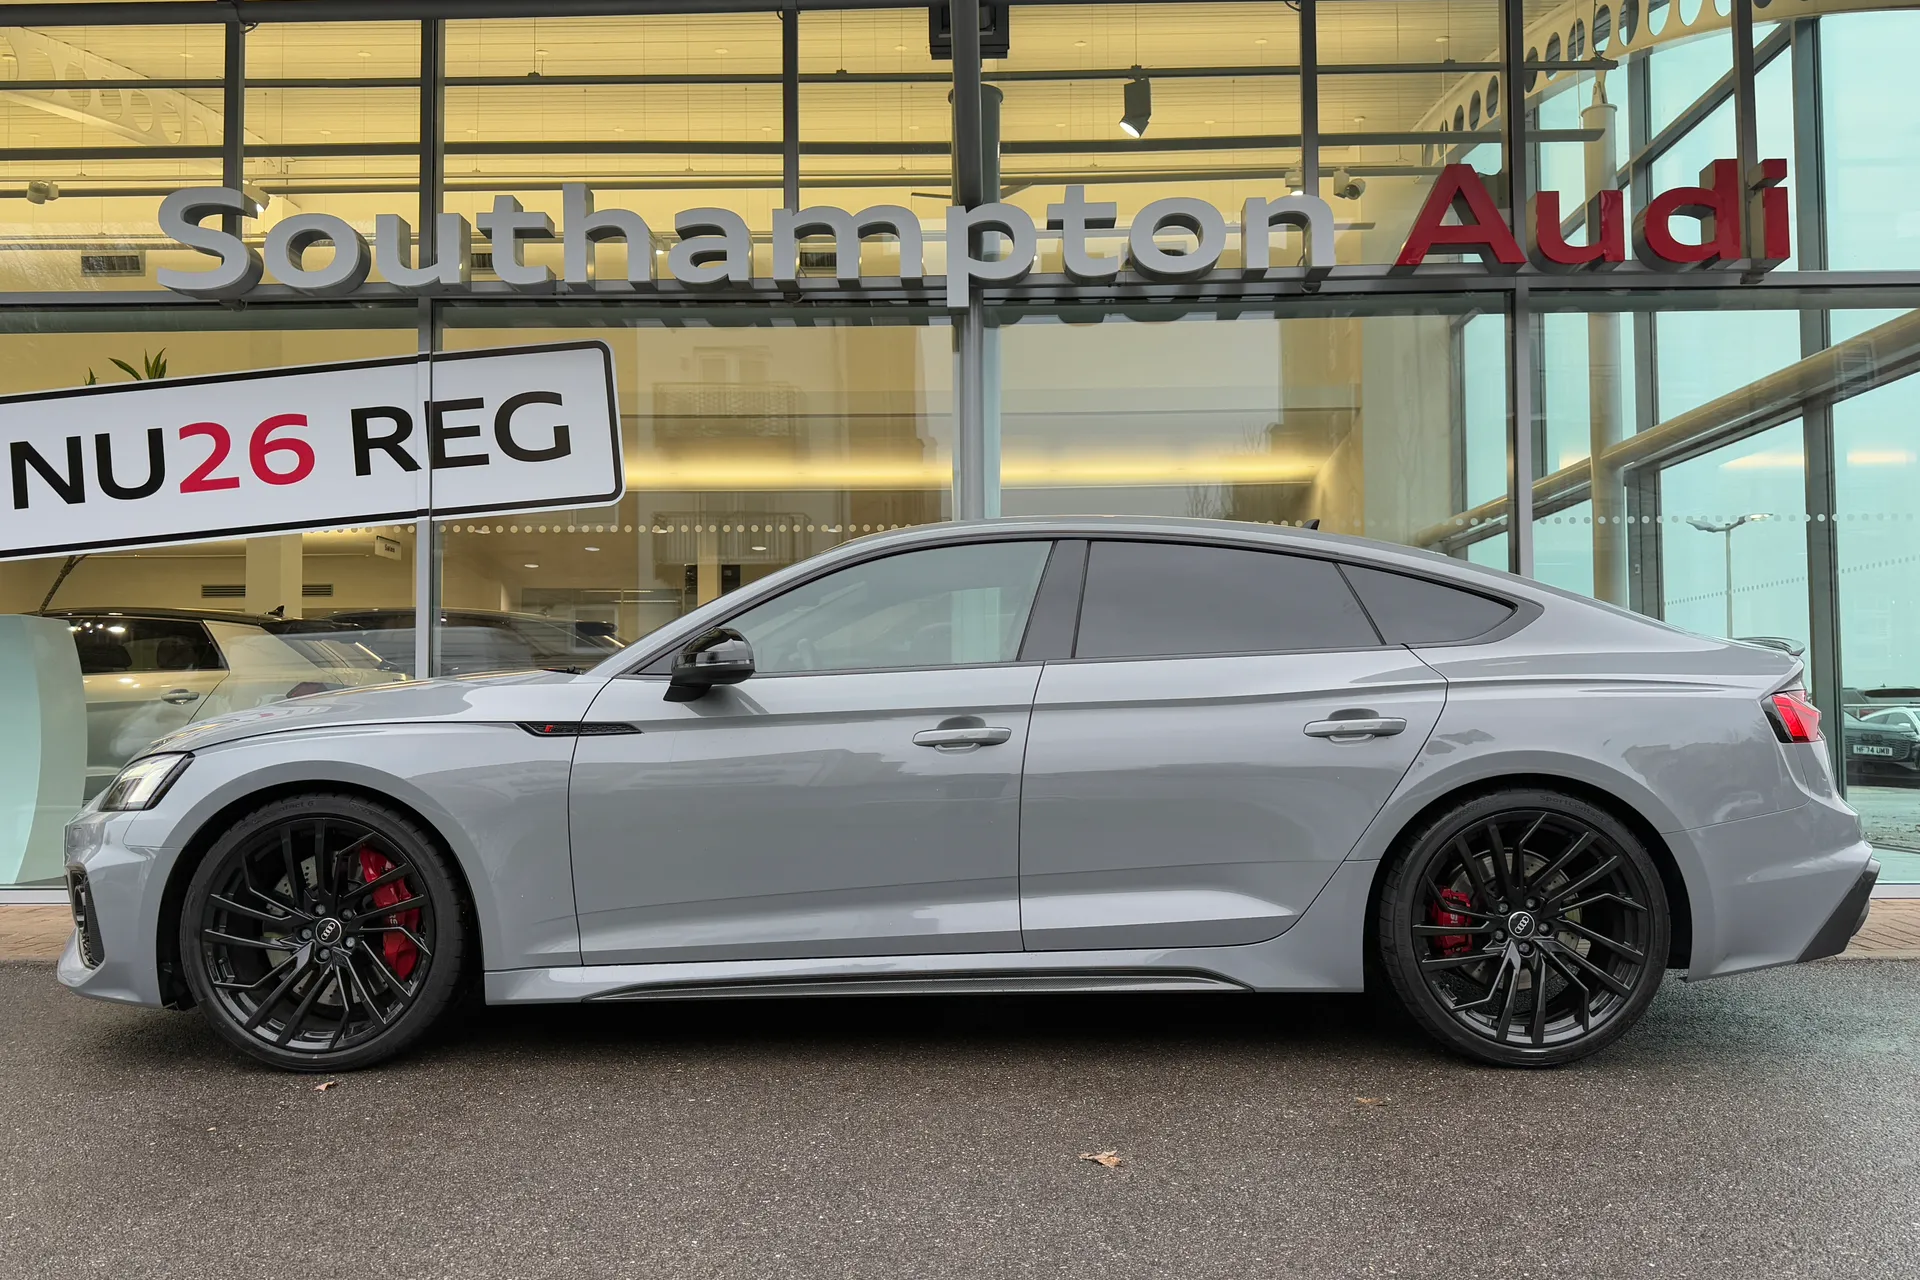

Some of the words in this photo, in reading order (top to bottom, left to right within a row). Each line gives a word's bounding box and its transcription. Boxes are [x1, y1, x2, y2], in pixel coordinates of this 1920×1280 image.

[156, 183, 1334, 308] Southampton
[1395, 159, 1791, 268] Audi
[10, 413, 317, 510] NU26
[350, 391, 572, 477] REG
